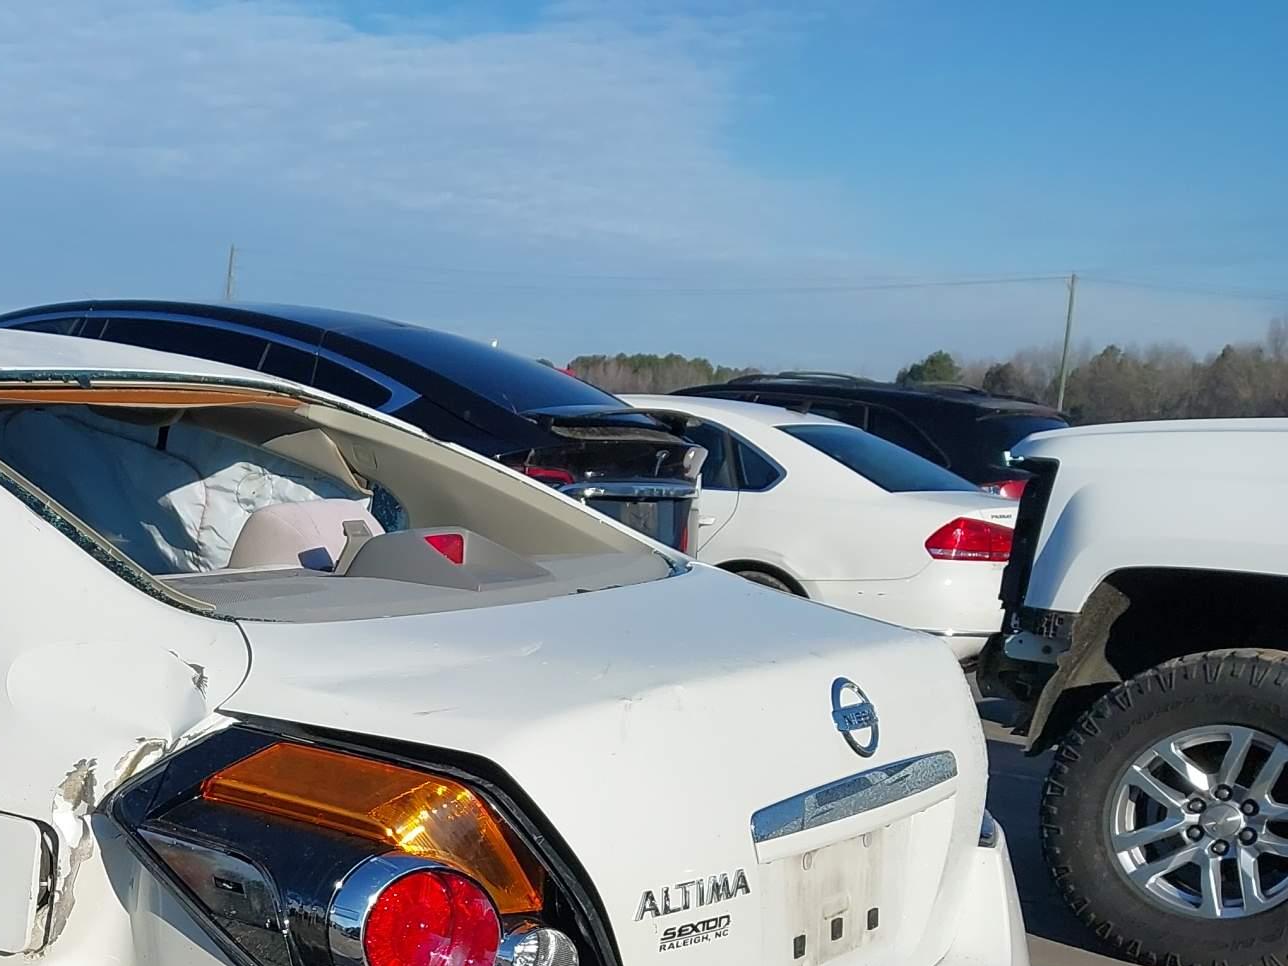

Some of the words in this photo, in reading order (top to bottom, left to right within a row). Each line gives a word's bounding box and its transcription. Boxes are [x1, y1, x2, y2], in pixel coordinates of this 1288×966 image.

[634, 868, 751, 922] ALTIMA
[658, 934, 711, 953] RALEIGH,
[714, 929, 729, 939] NC
[660, 914, 731, 941] SEXTON
